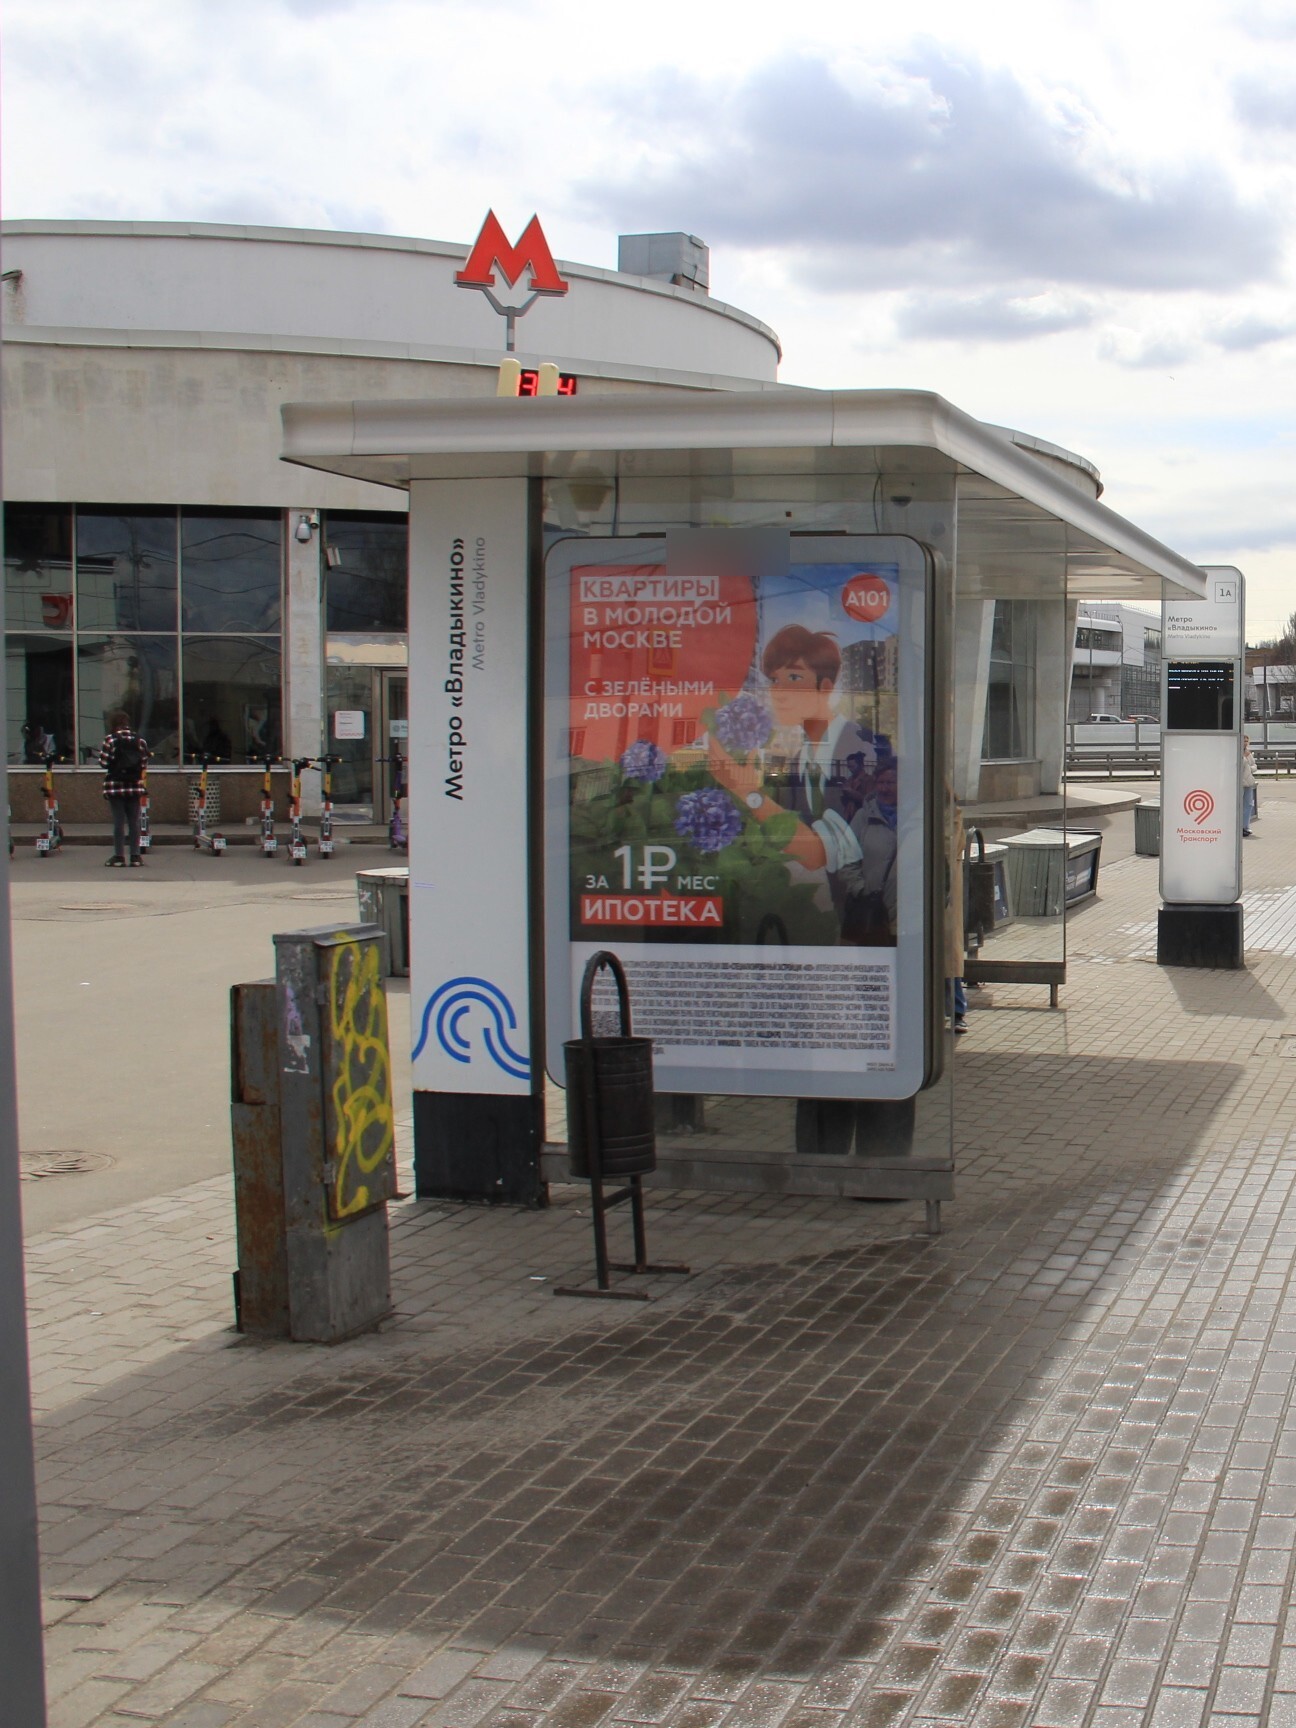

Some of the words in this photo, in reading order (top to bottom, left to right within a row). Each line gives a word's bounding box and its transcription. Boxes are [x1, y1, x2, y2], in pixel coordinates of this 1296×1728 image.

[472, 536, 489, 616] Vladykino
[583, 579, 716, 599] КВАРТИРЫ
[444, 537, 467, 708] «Владыкино»
[583, 607, 598, 625] В
[605, 601, 732, 628] МОЛОДОЙ
[1167, 624, 1218, 632] «Владыкино»
[472, 620, 485, 671] Metro
[583, 630, 683, 649] МОСКВЕ
[584, 681, 597, 695] С
[602, 677, 714, 696] ЗЕЛЁНЫМИ
[584, 702, 683, 720] ДВОРАМИ
[445, 715, 467, 801] Метро
[1179, 834, 1218, 843] Транспорт
[585, 875, 609, 889] ЗА
[584, 898, 721, 922] ИПОТЕКА
